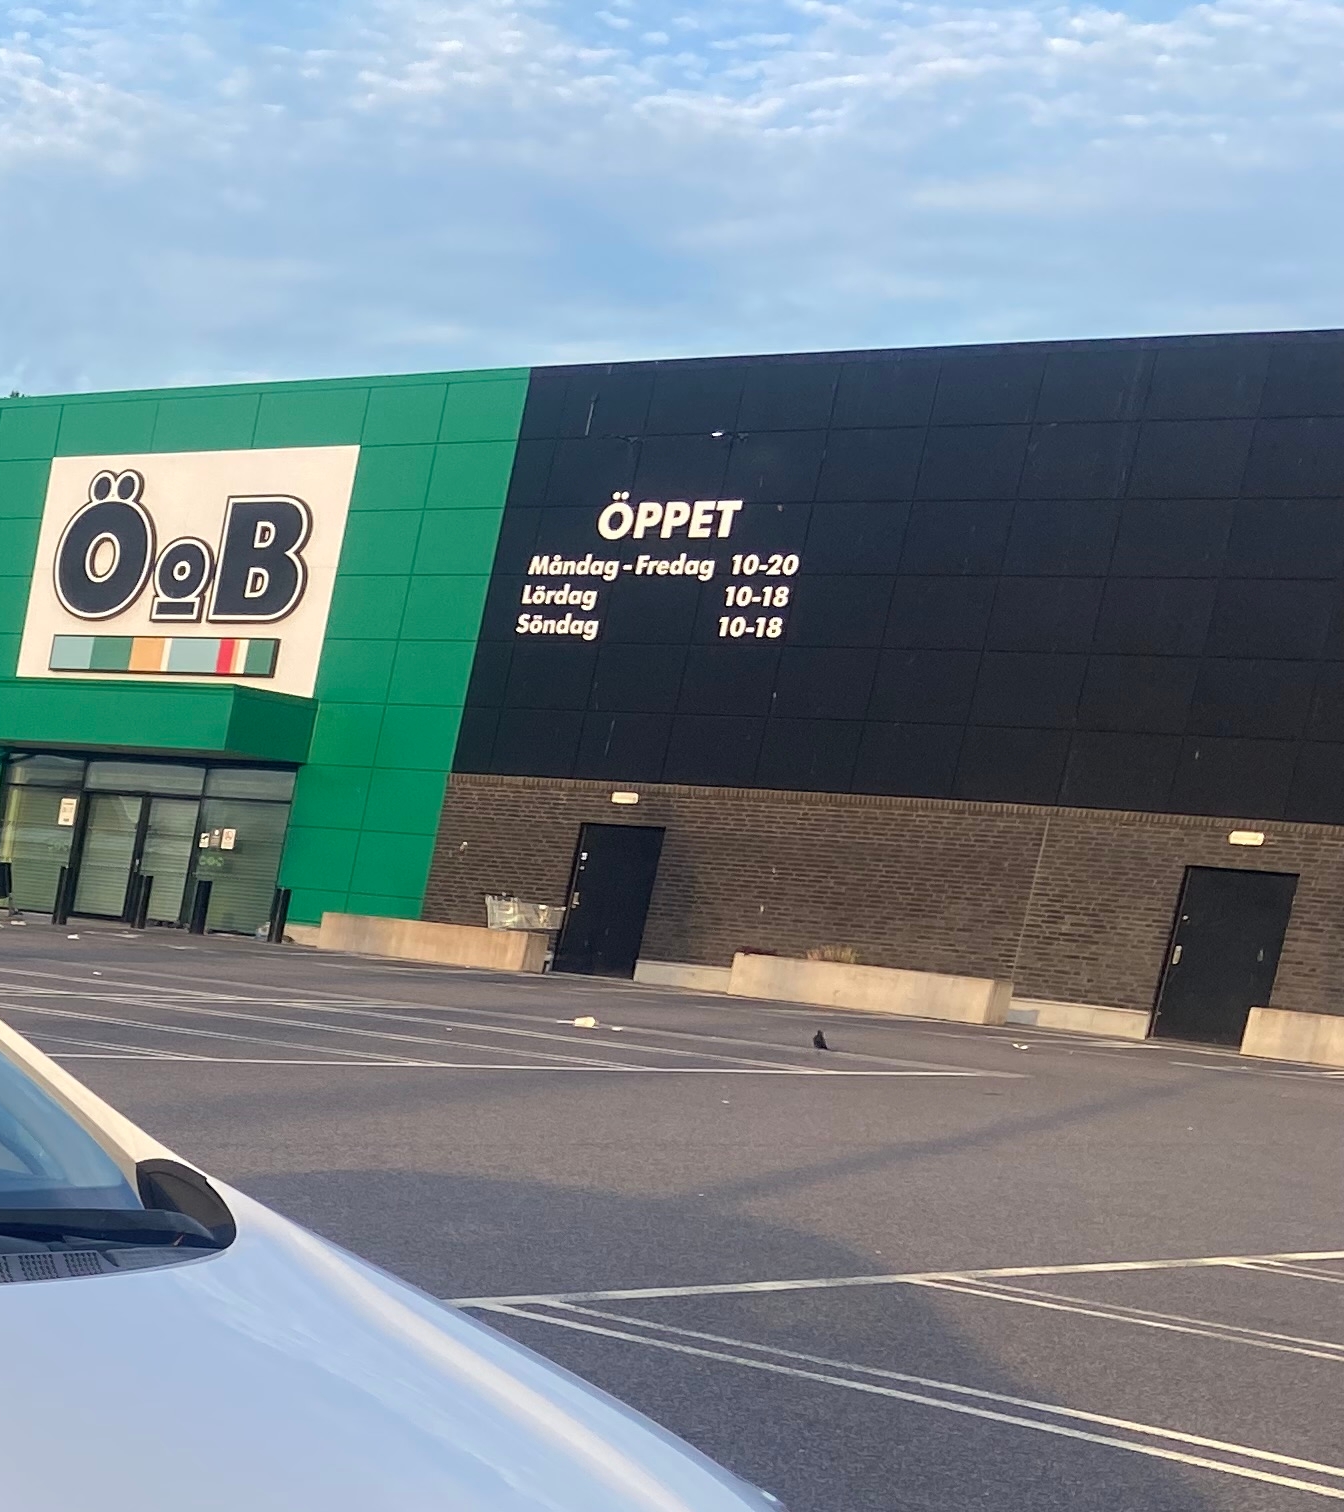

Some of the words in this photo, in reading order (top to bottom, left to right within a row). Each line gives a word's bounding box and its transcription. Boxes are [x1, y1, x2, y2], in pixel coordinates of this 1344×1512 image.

[597, 491, 743, 540] ÖPPET
[528, 554, 619, 581] Måndag
[635, 553, 715, 581] Fredag
[731, 554, 799, 576] 10-20
[521, 584, 598, 611] Lördag
[724, 586, 789, 608] 10-18
[515, 613, 600, 641] Söndag
[717, 617, 784, 638] 10-18
